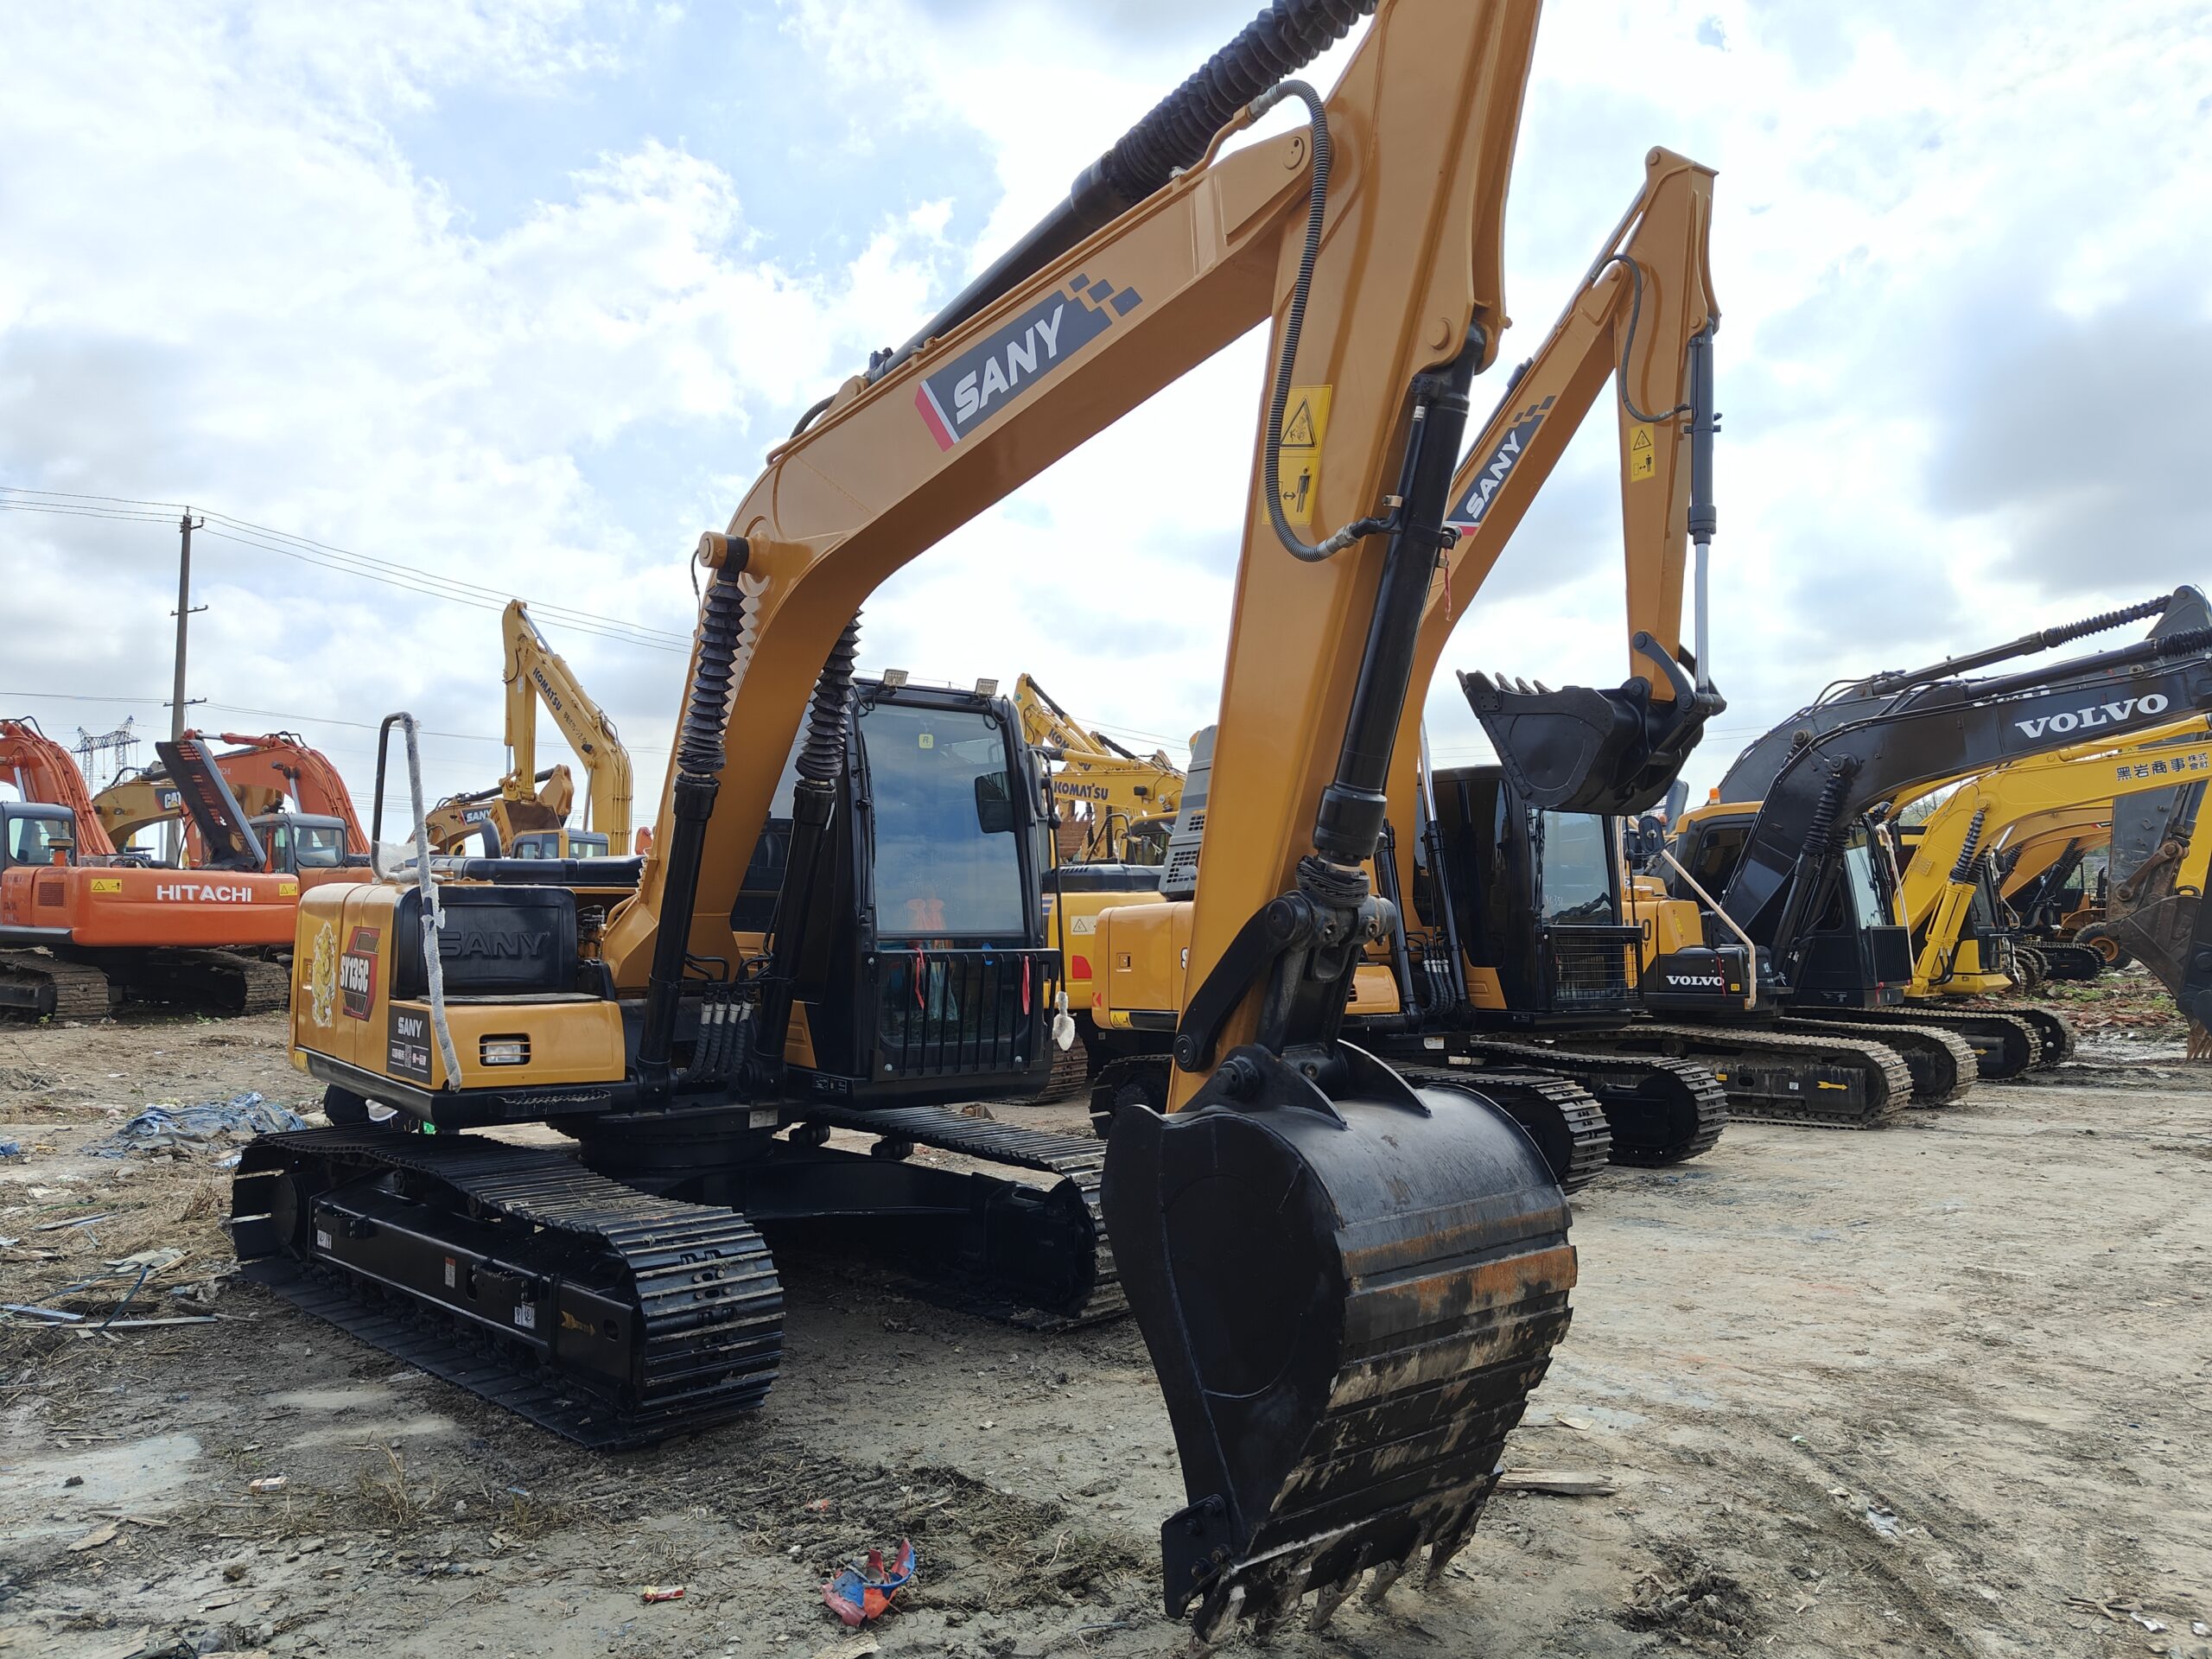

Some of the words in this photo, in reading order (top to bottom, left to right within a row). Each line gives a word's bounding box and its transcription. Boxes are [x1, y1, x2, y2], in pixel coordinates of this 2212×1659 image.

[954, 304, 1064, 425] SANY
[1466, 430, 1522, 520] SANY
[2015, 694, 2169, 739] VOLVO
[156, 884, 252, 902] HITACHI
[438, 931, 546, 957] SANY
[340, 955, 370, 993] SY135C
[1666, 976, 1725, 987] VOLVO
[397, 1016, 423, 1039] SANY
